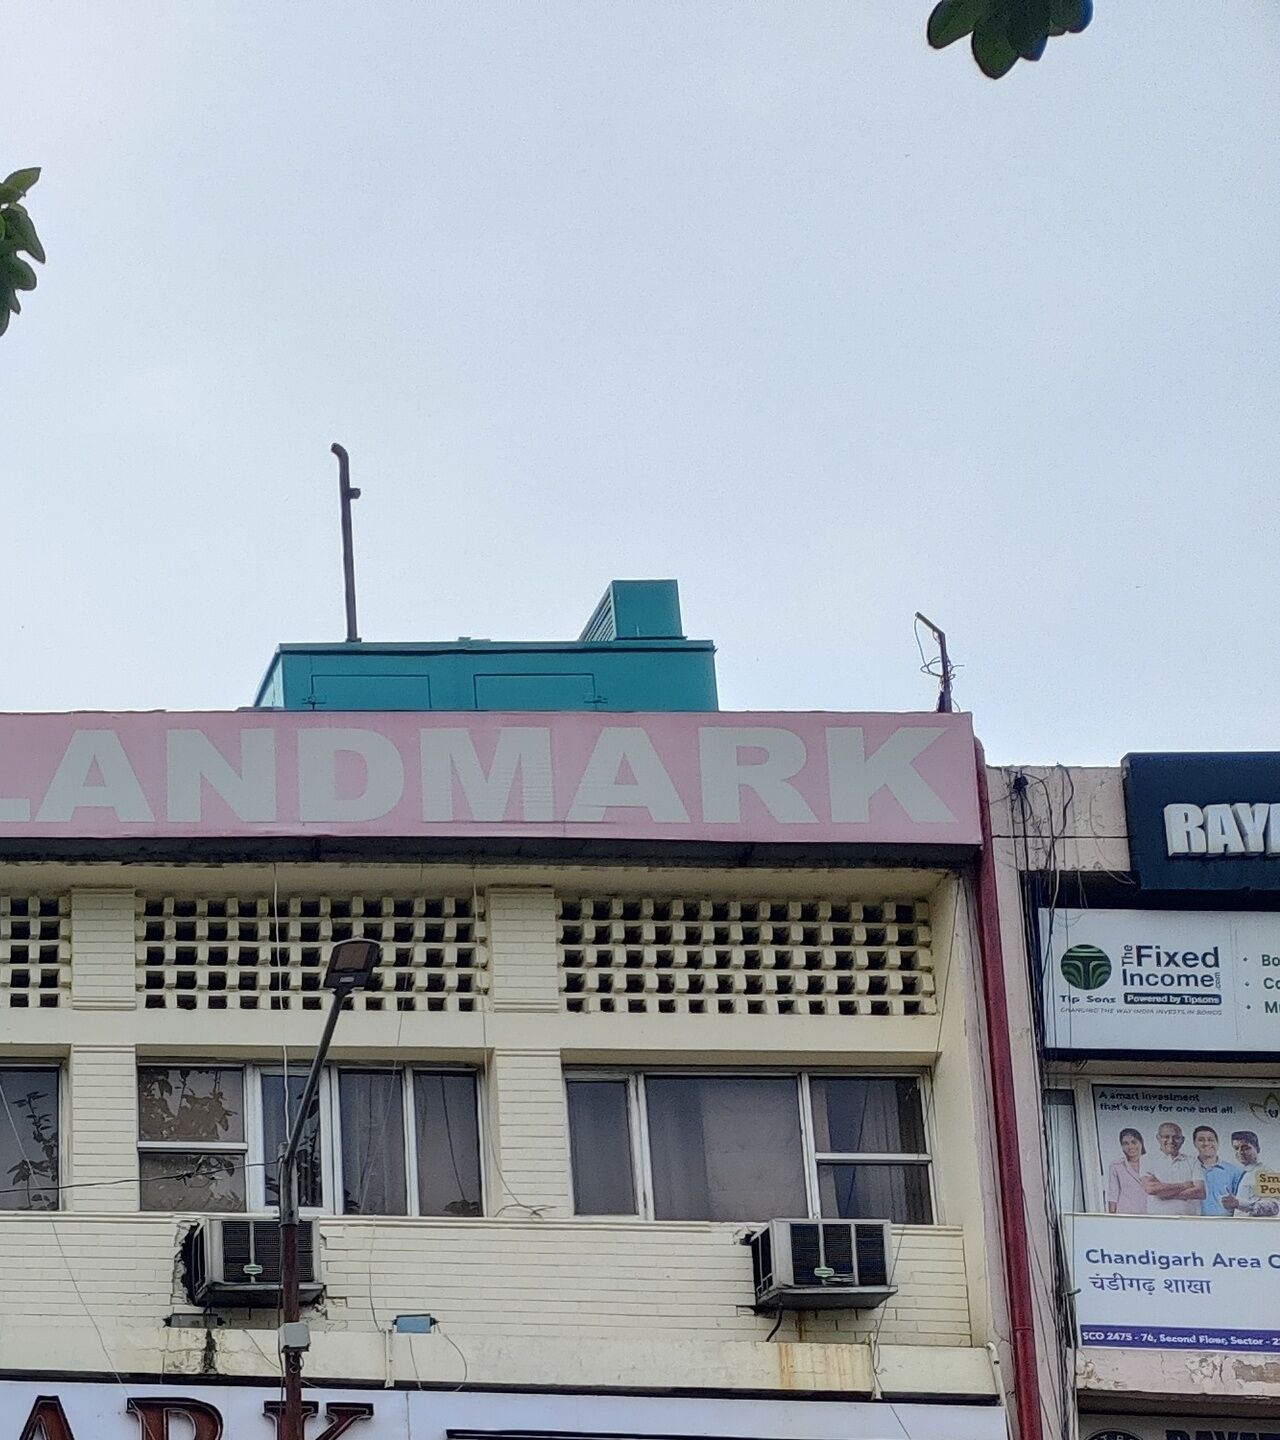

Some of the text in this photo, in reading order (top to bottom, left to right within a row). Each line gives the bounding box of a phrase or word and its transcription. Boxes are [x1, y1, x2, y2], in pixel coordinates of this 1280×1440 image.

[1122, 945, 1132, 966] The
[1136, 945, 1220, 968] Fixed
[1122, 969, 1214, 987] Income
[1059, 995, 1081, 1005] Tip
[1127, 995, 1168, 1004] Powered
[1169, 996, 1182, 1005] by
[1099, 1091, 1200, 1102] A smart investment
[1100, 1103, 1128, 1111] that's
[1132, 1104, 1156, 1114] easy
[1158, 1104, 1173, 1113] for
[1199, 1105, 1218, 1114] and
[1259, 1174, 1280, 1183] Sm
[1086, 1249, 1204, 1270] Chandigarh
[1212, 1253, 1262, 1268] Area
[1089, 1272, 1212, 1296] चंडीगढ़ शाखा
[1082, 1331, 1105, 1341] SCO
[1159, 1334, 1196, 1344] Second
[1199, 1335, 1228, 1346] Floor,
[1230, 1336, 1264, 1346] Sector
